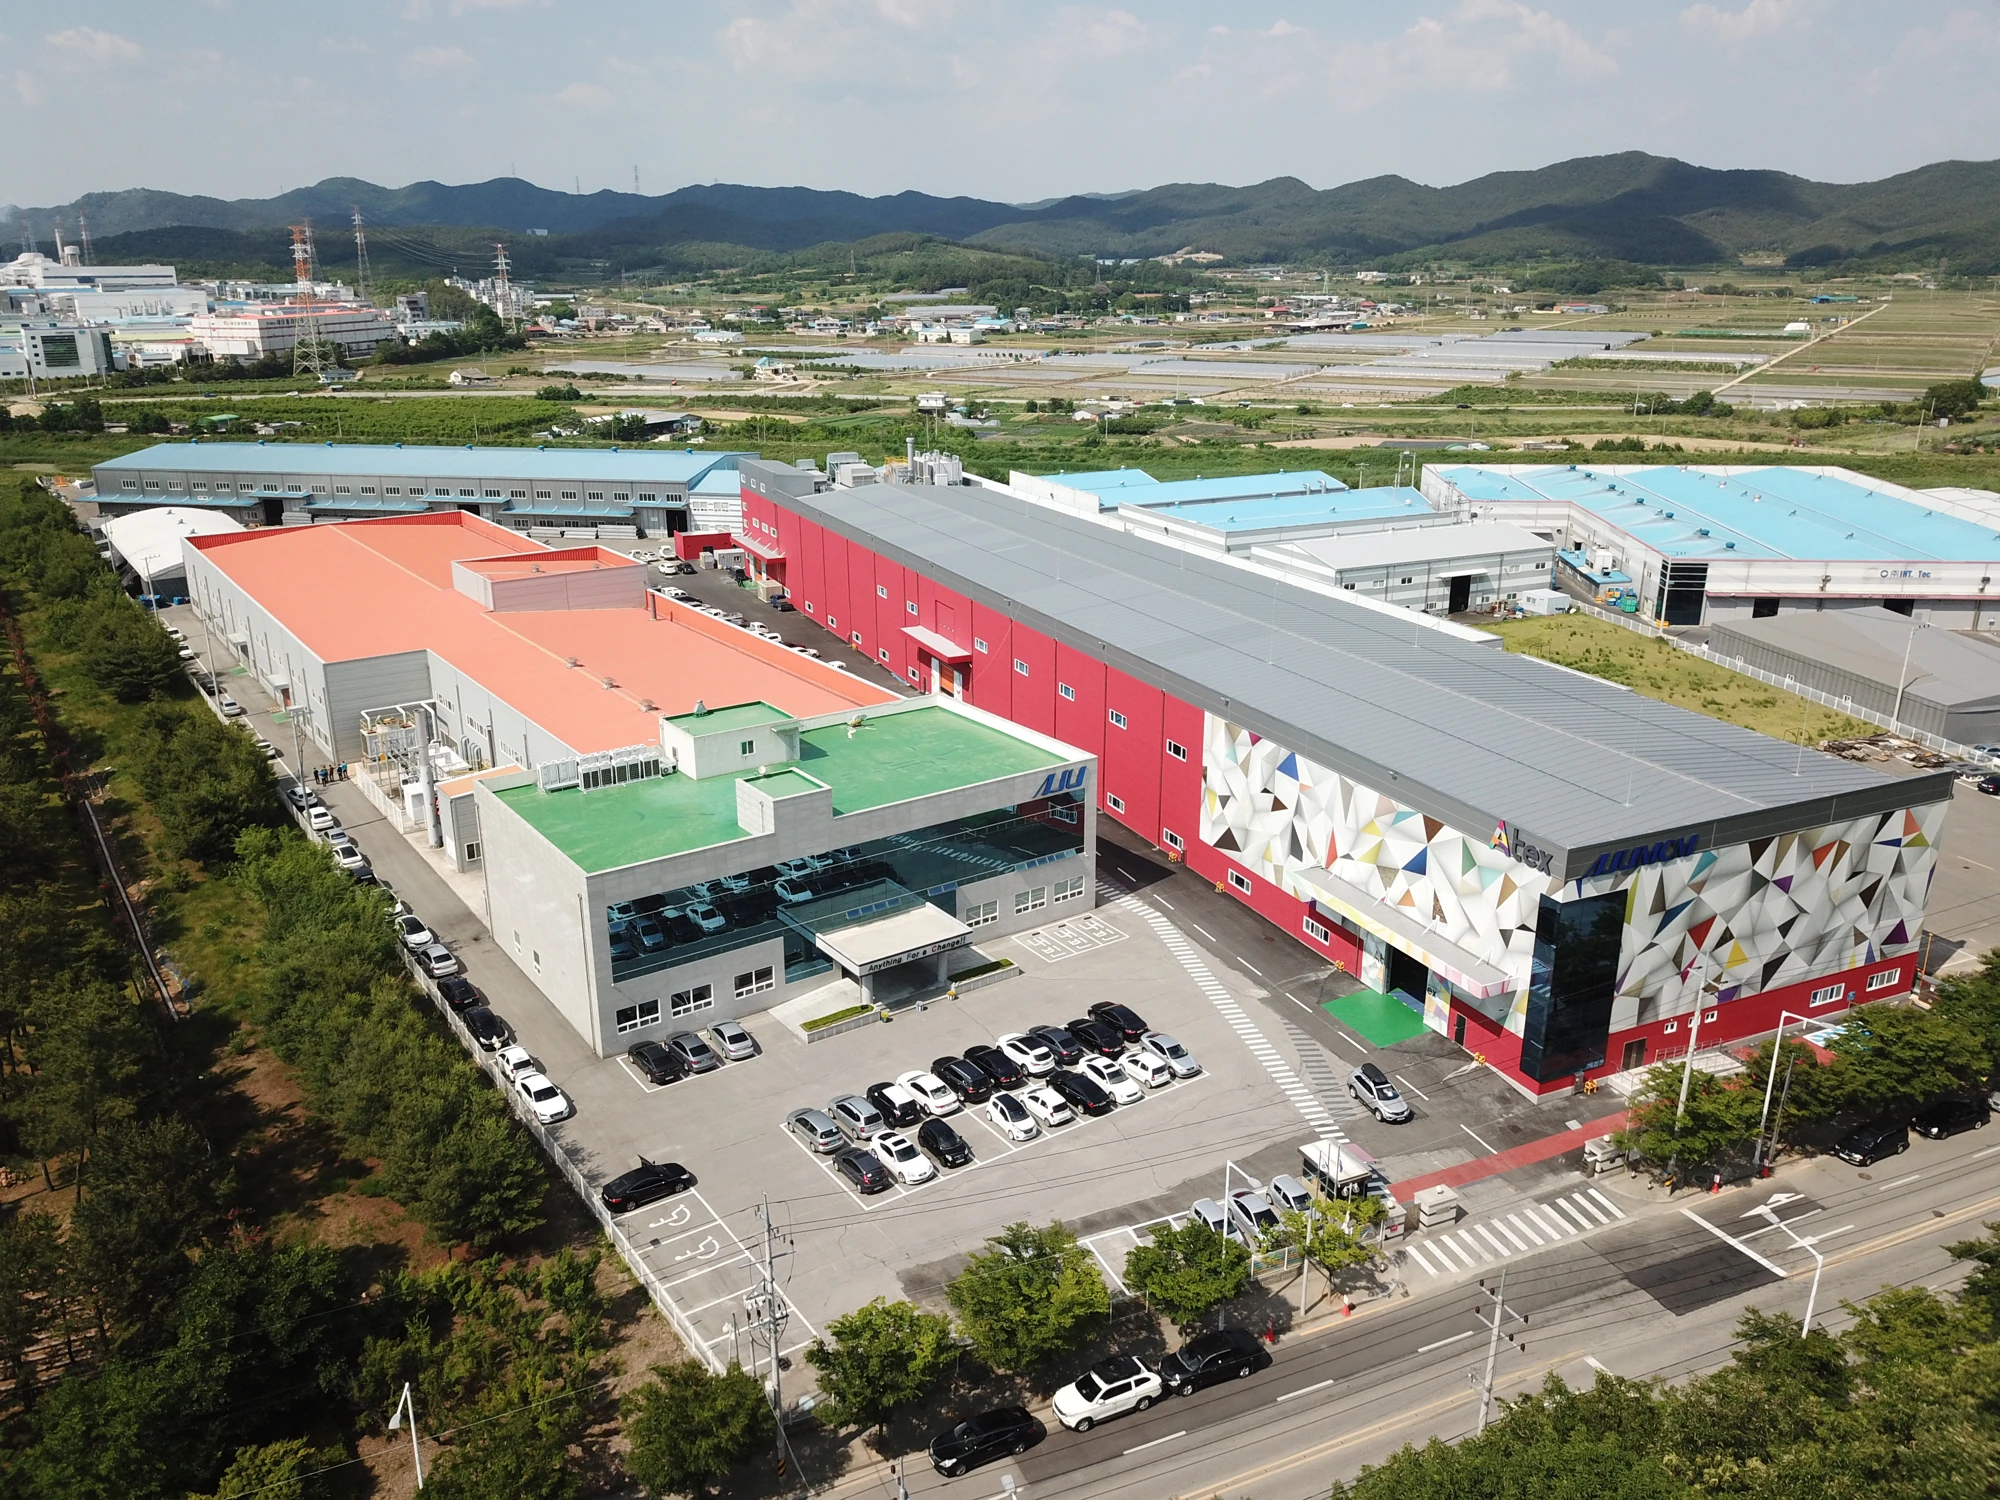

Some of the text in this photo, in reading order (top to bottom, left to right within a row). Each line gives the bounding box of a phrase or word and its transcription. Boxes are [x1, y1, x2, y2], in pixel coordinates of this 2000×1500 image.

[1918, 570, 1931, 578] Tec
[1031, 766, 1087, 799] AJU
[1488, 820, 1554, 876] Atex
[868, 956, 902, 972] Anything
[906, 951, 920, 961] For
[931, 936, 966, 952] Change!!
